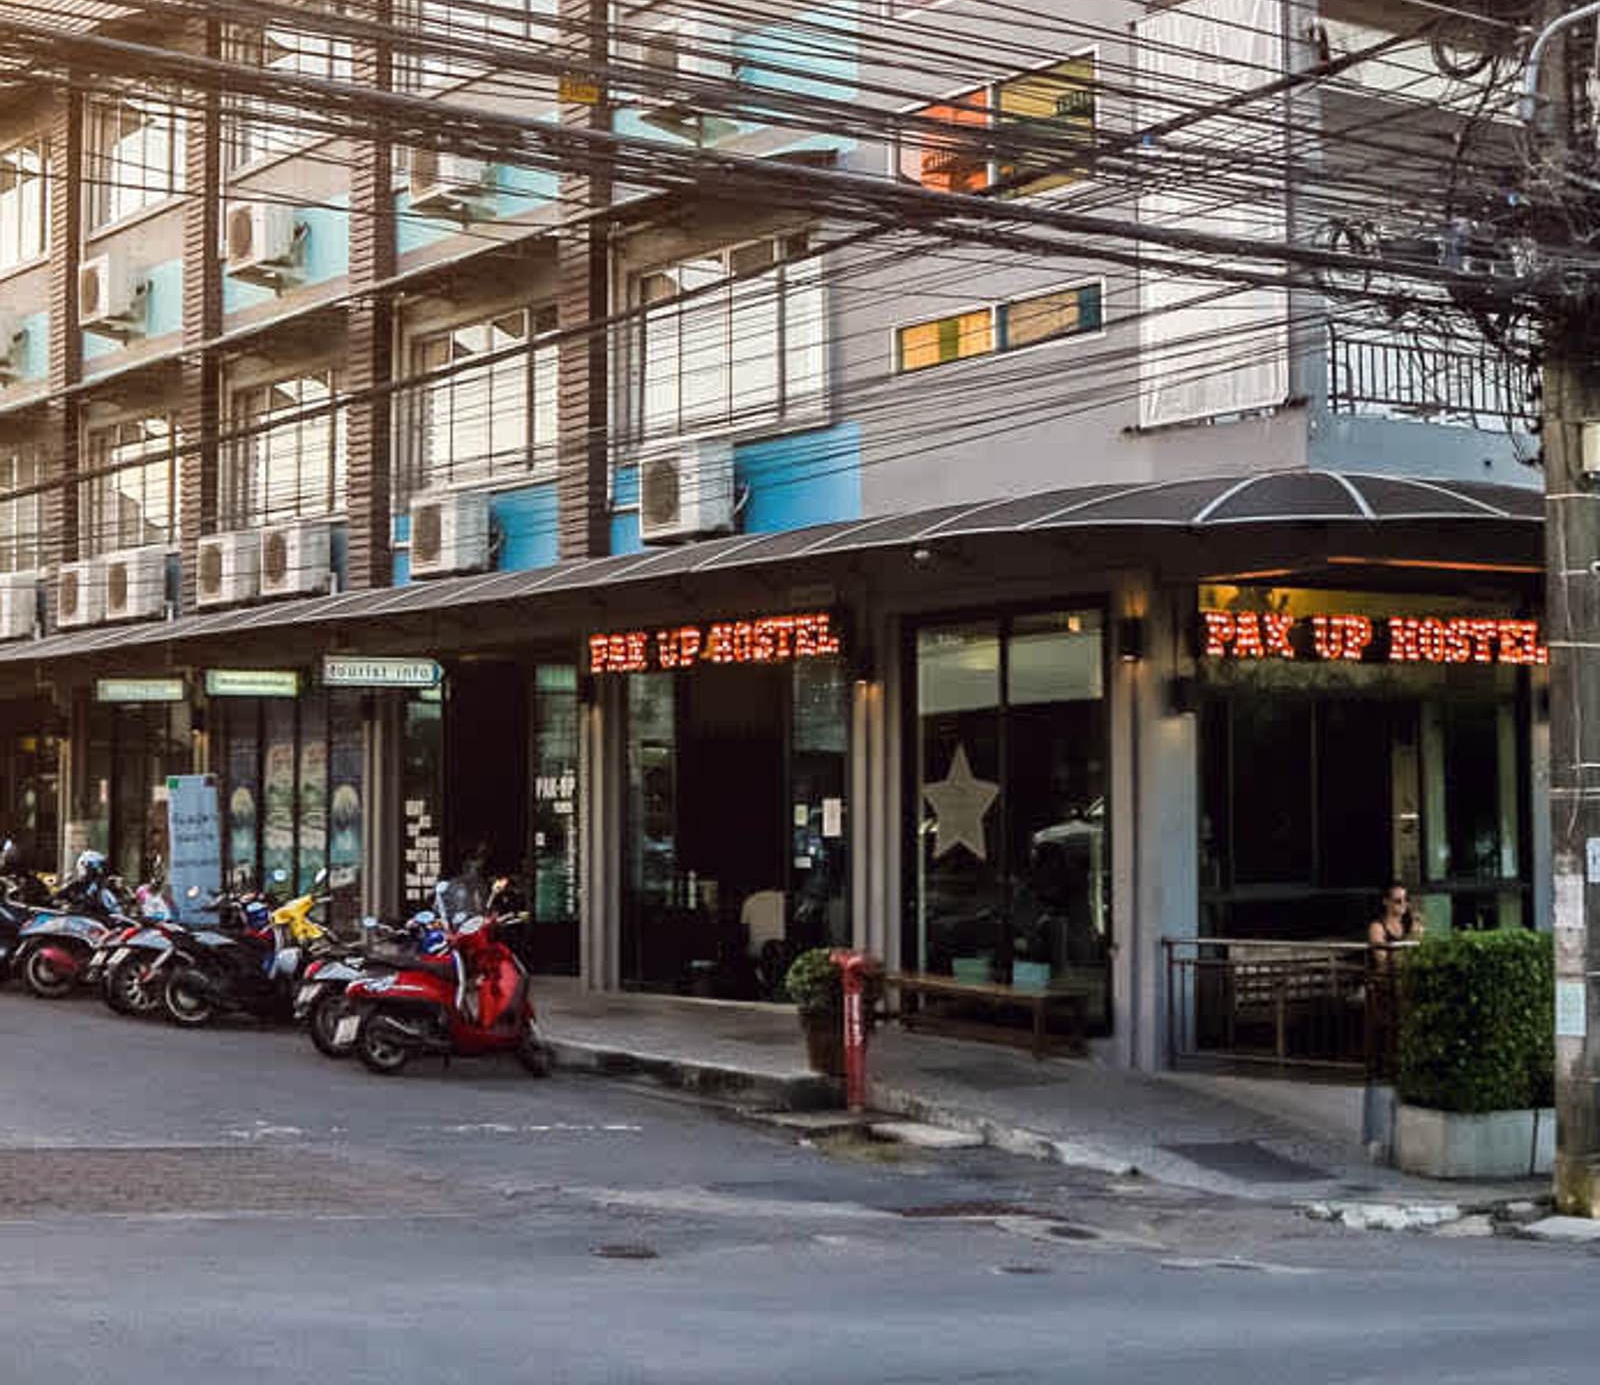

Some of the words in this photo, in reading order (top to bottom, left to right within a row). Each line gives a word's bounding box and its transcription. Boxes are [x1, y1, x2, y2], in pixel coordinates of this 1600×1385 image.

[656, 626, 700, 667] UP
[711, 613, 839, 663] HOSTEL
[1203, 612, 1294, 658] PAK
[1312, 615, 1372, 659] UP
[1388, 616, 1547, 664] HOSTEL
[328, 664, 387, 677] tourist
[395, 664, 431, 679] info
